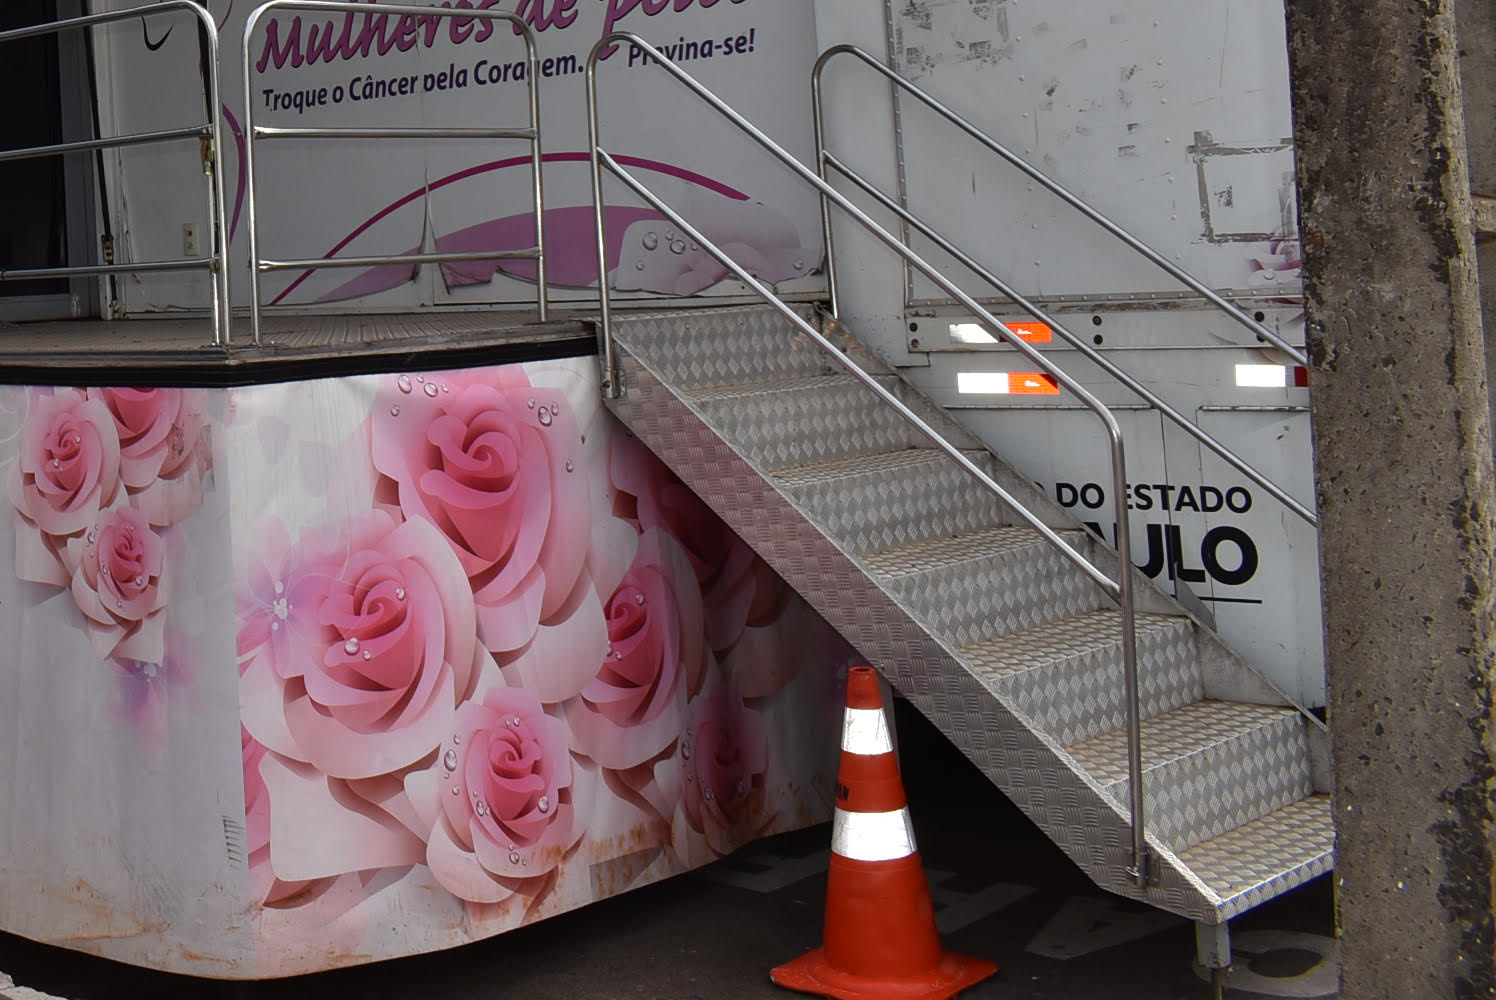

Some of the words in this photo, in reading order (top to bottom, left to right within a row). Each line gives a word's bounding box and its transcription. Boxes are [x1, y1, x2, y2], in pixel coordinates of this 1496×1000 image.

[262, 88, 328, 115] Troque
[332, 86, 345, 103] o
[349, 70, 419, 101] Câncer
[473, 53, 584, 87] Coraem.
[1056, 482, 1105, 509] DO
